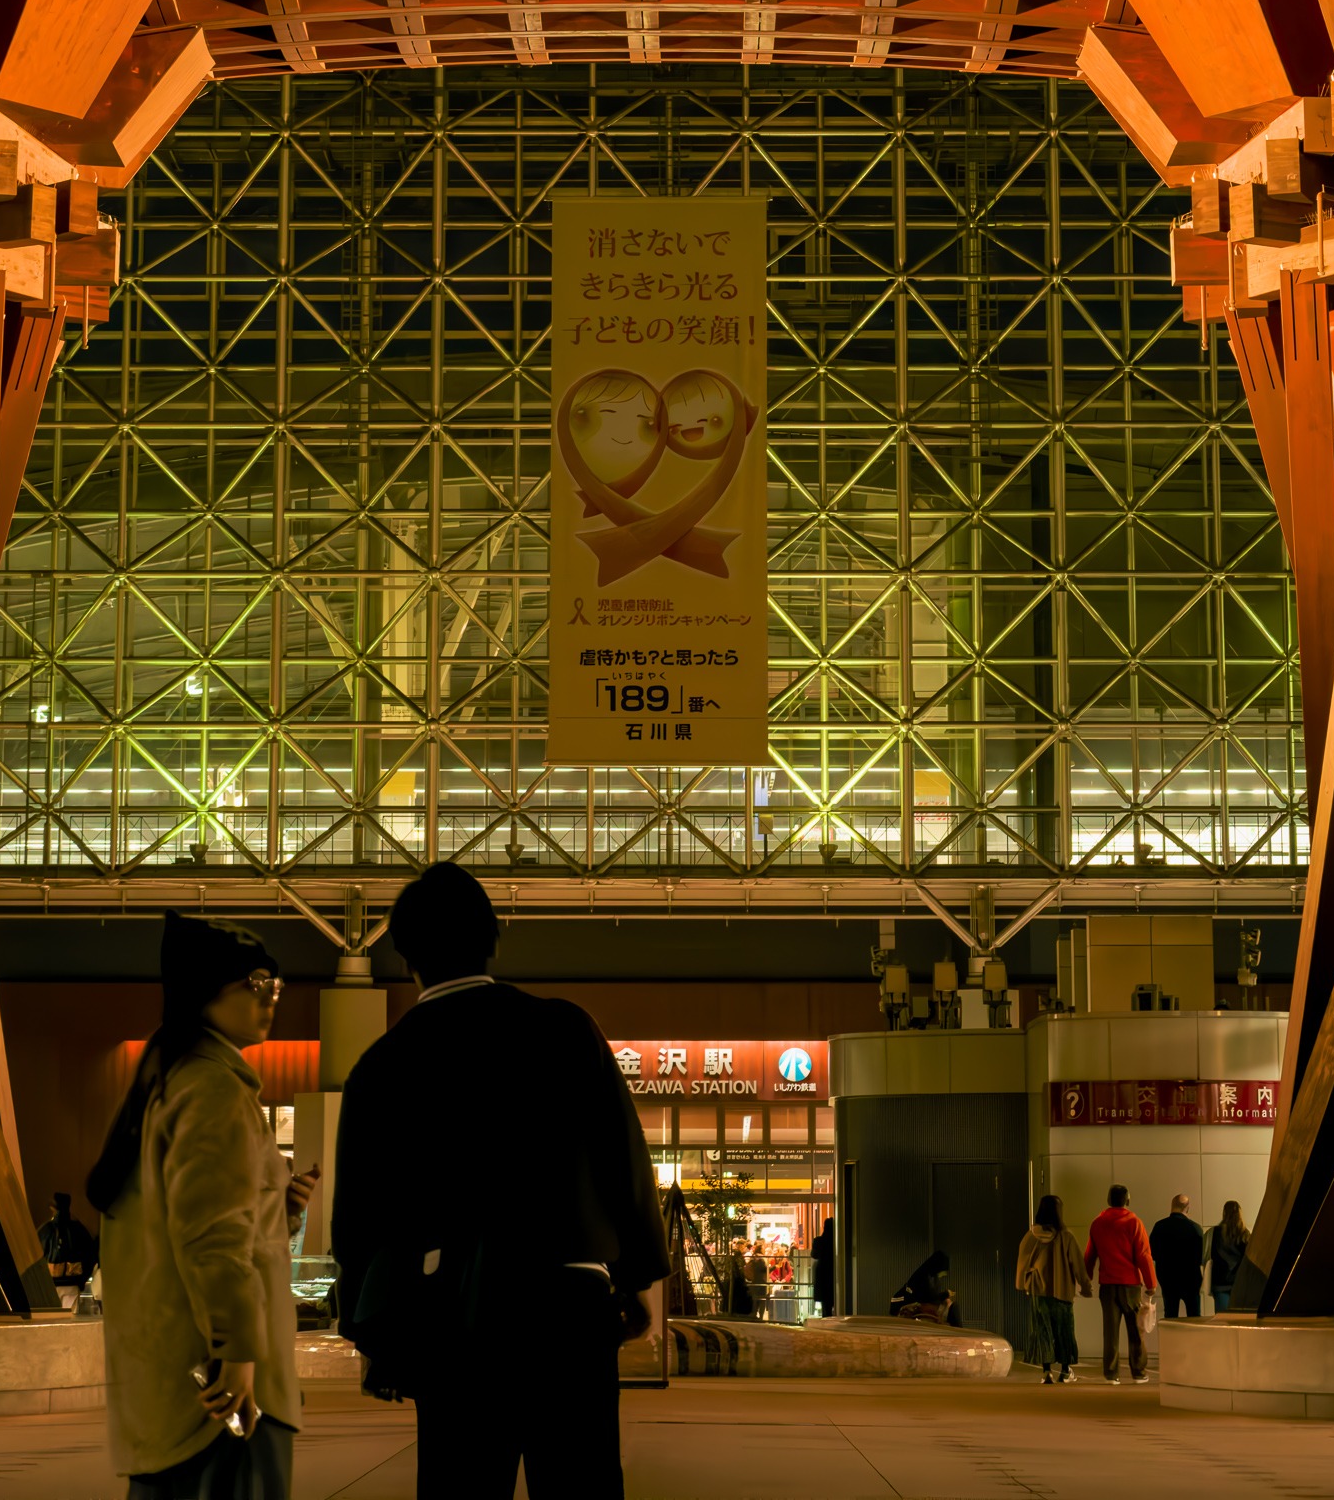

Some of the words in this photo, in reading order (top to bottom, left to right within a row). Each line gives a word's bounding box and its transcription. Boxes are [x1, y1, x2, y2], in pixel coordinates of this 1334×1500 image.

[588, 228, 731, 258] 消さないで
[580, 272, 739, 301] きらきら光る
[597, 614, 752, 627] オレンジリボンキャンペーン
[625, 723, 692, 740] 石川県
[614, 1047, 734, 1076] 金沢駅
[691, 1080, 758, 1094] STATION
